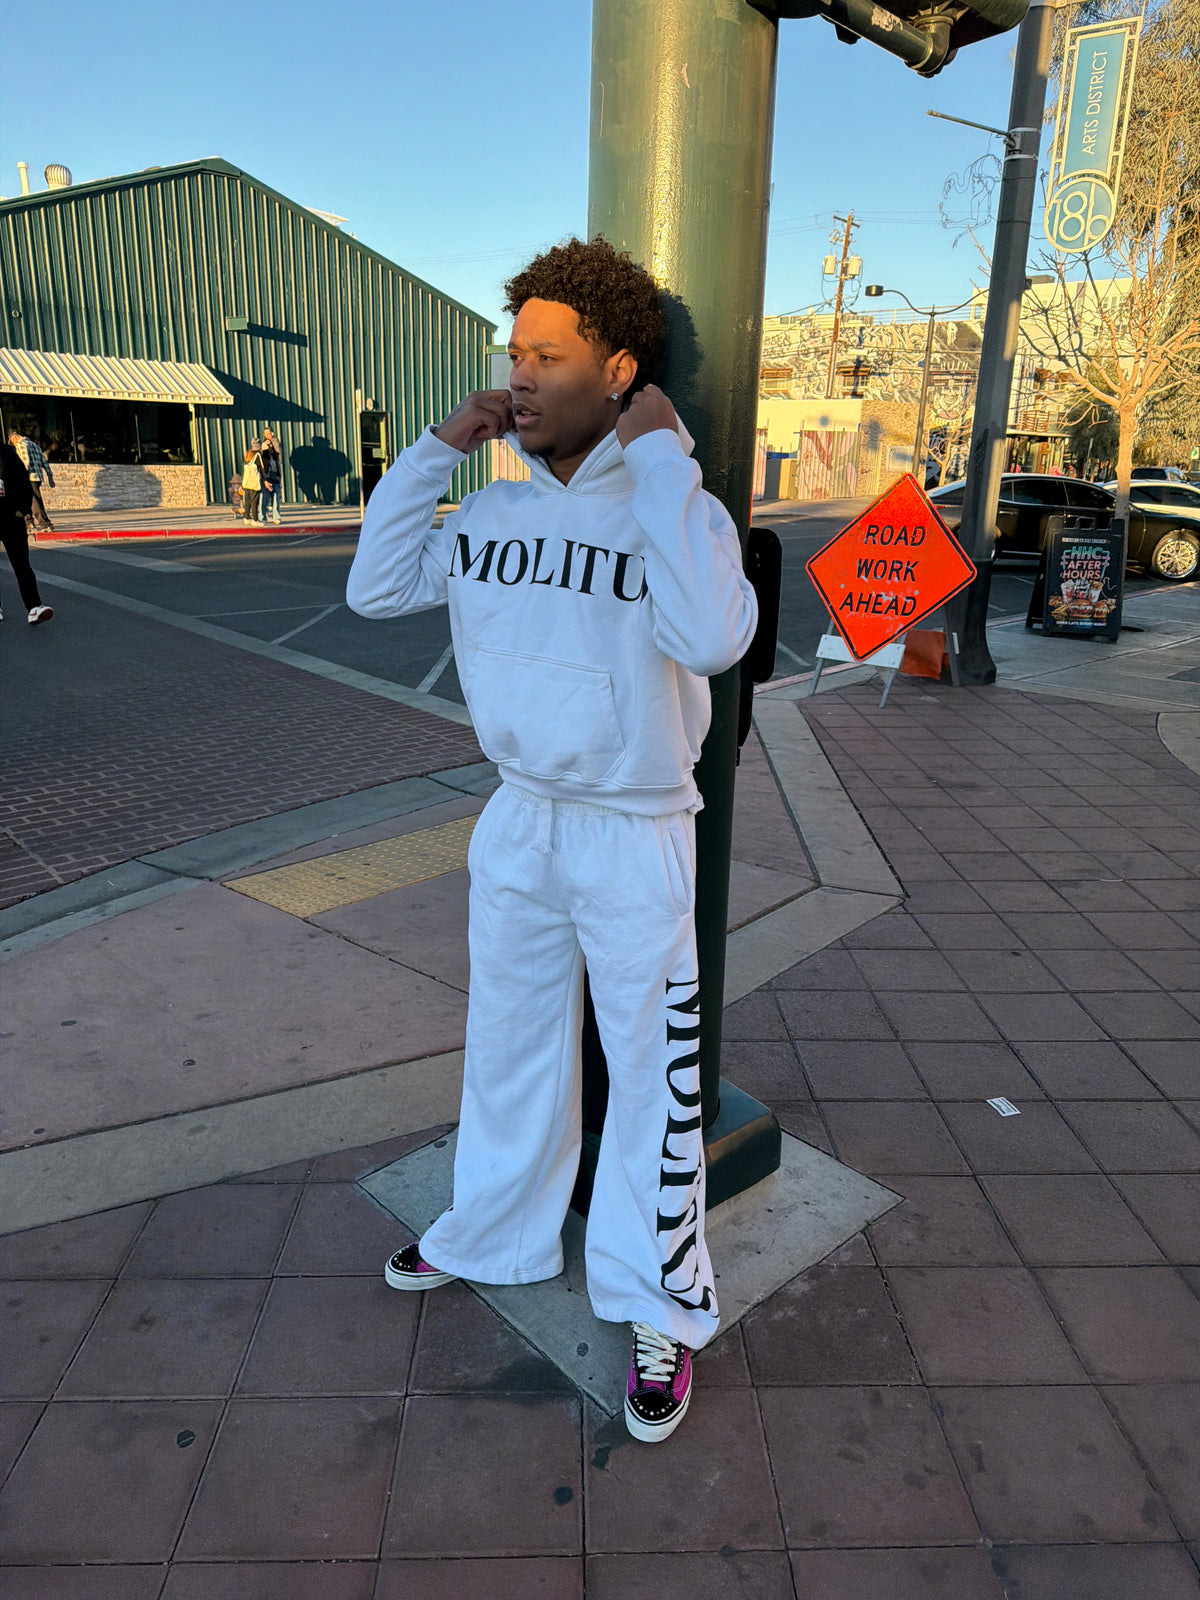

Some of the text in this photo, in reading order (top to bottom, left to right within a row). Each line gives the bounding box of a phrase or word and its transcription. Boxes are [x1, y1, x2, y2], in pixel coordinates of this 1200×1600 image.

[1082, 50, 1108, 155] ARTS DISTRICT
[864, 524, 926, 547] ROAD
[1070, 546, 1103, 560] HHC
[856, 558, 920, 582] WORK
[1062, 569, 1101, 579] HOURS
[1067, 560, 1102, 570] AFTER
[838, 592, 917, 617] AHEAD
